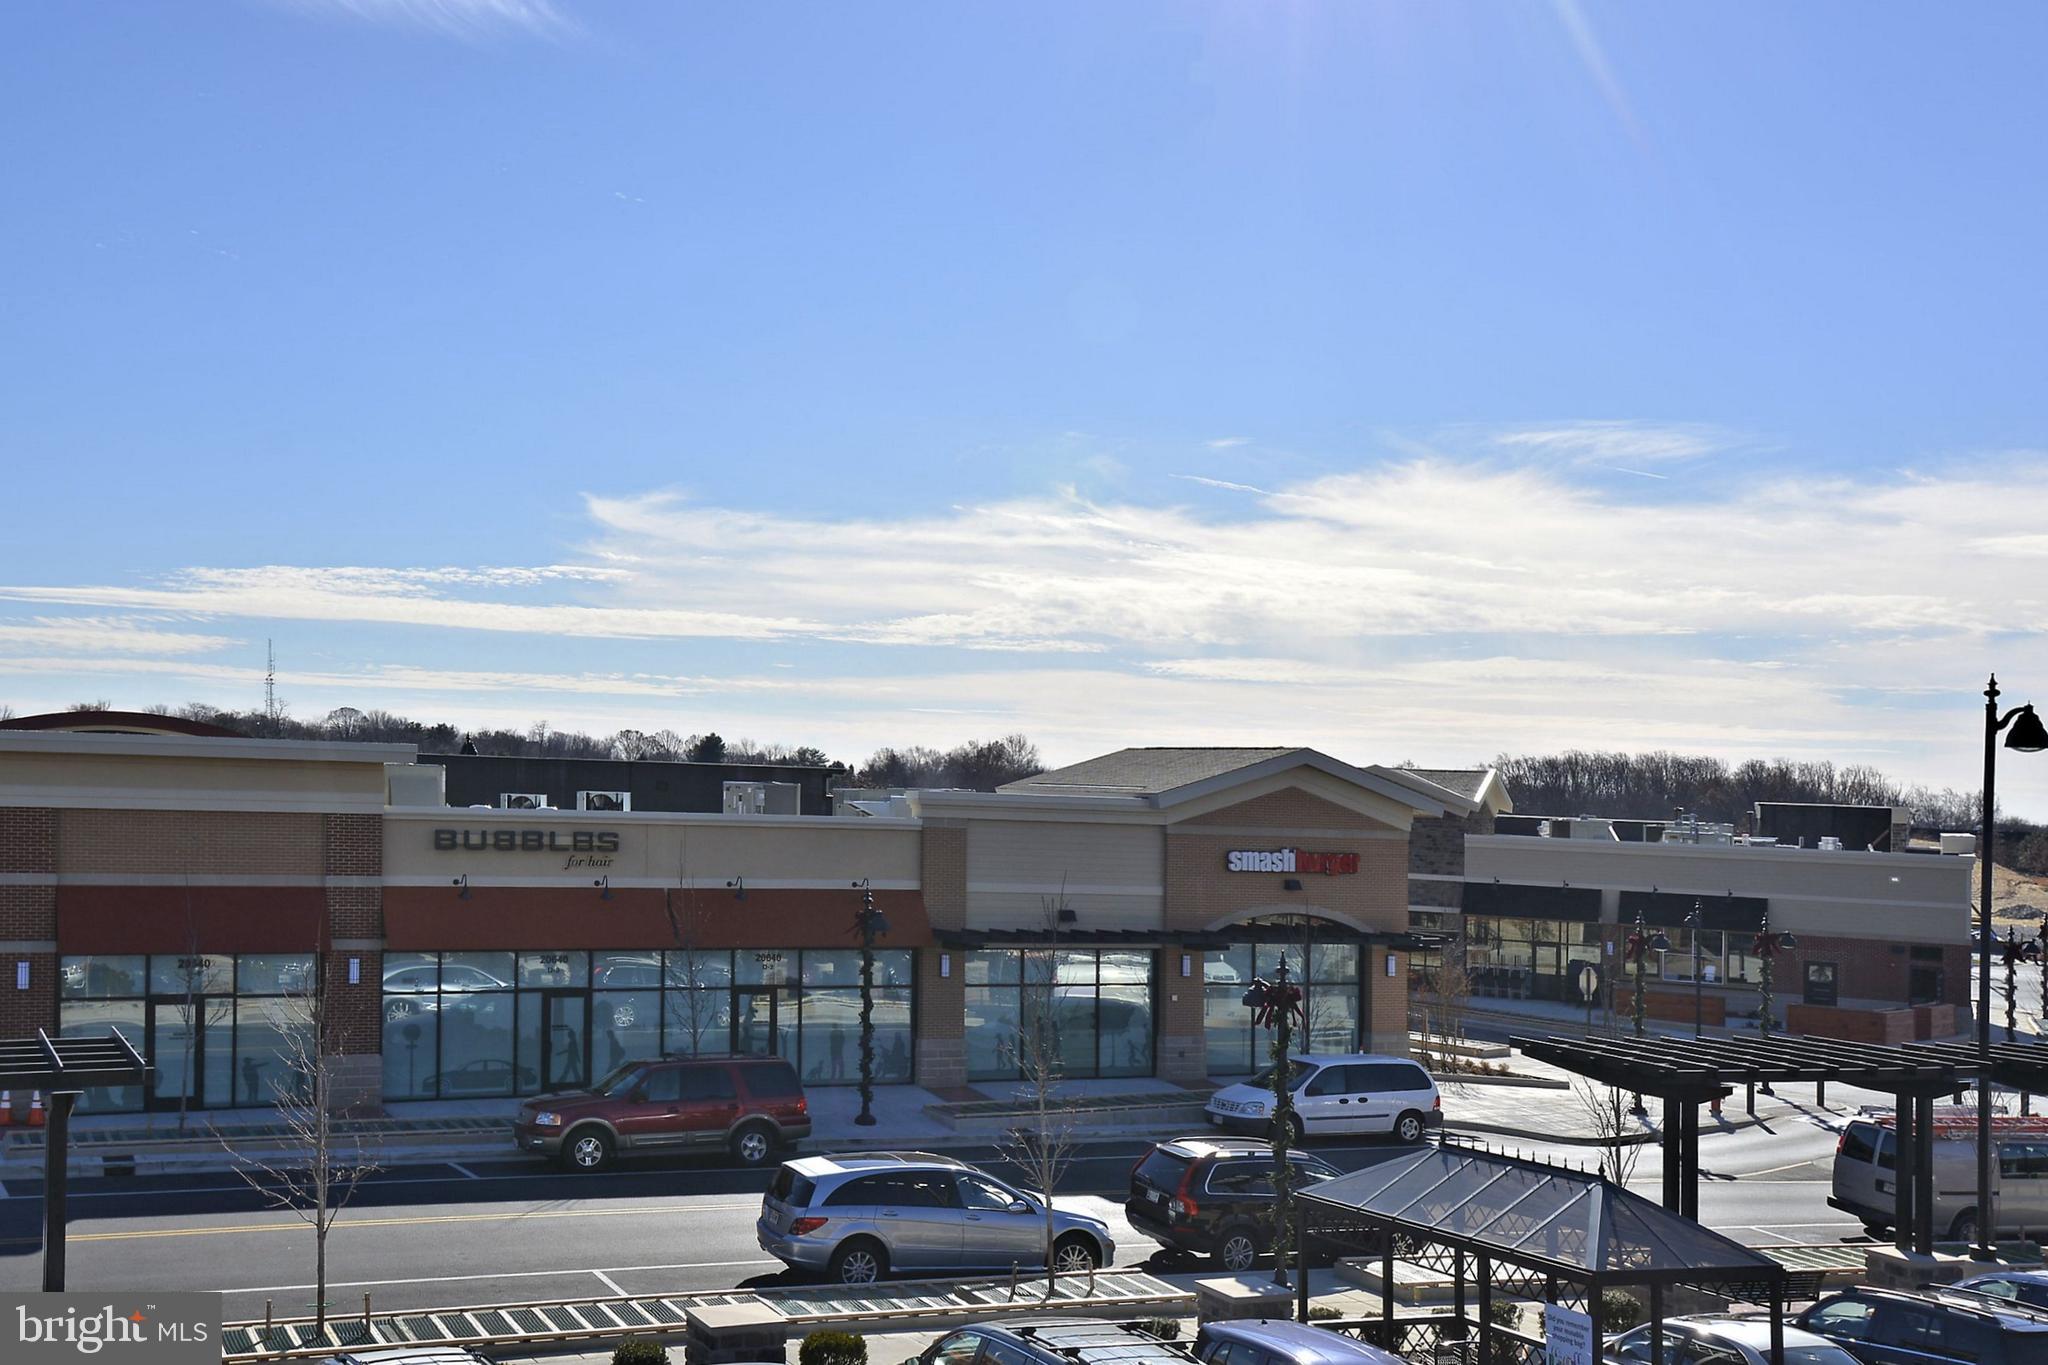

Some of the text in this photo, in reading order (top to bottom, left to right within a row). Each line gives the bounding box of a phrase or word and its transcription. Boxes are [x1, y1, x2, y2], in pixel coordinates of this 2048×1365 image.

[433, 829, 619, 852] BUBBLES
[564, 855, 614, 870] for hair
[1227, 847, 1361, 876] smashburger
